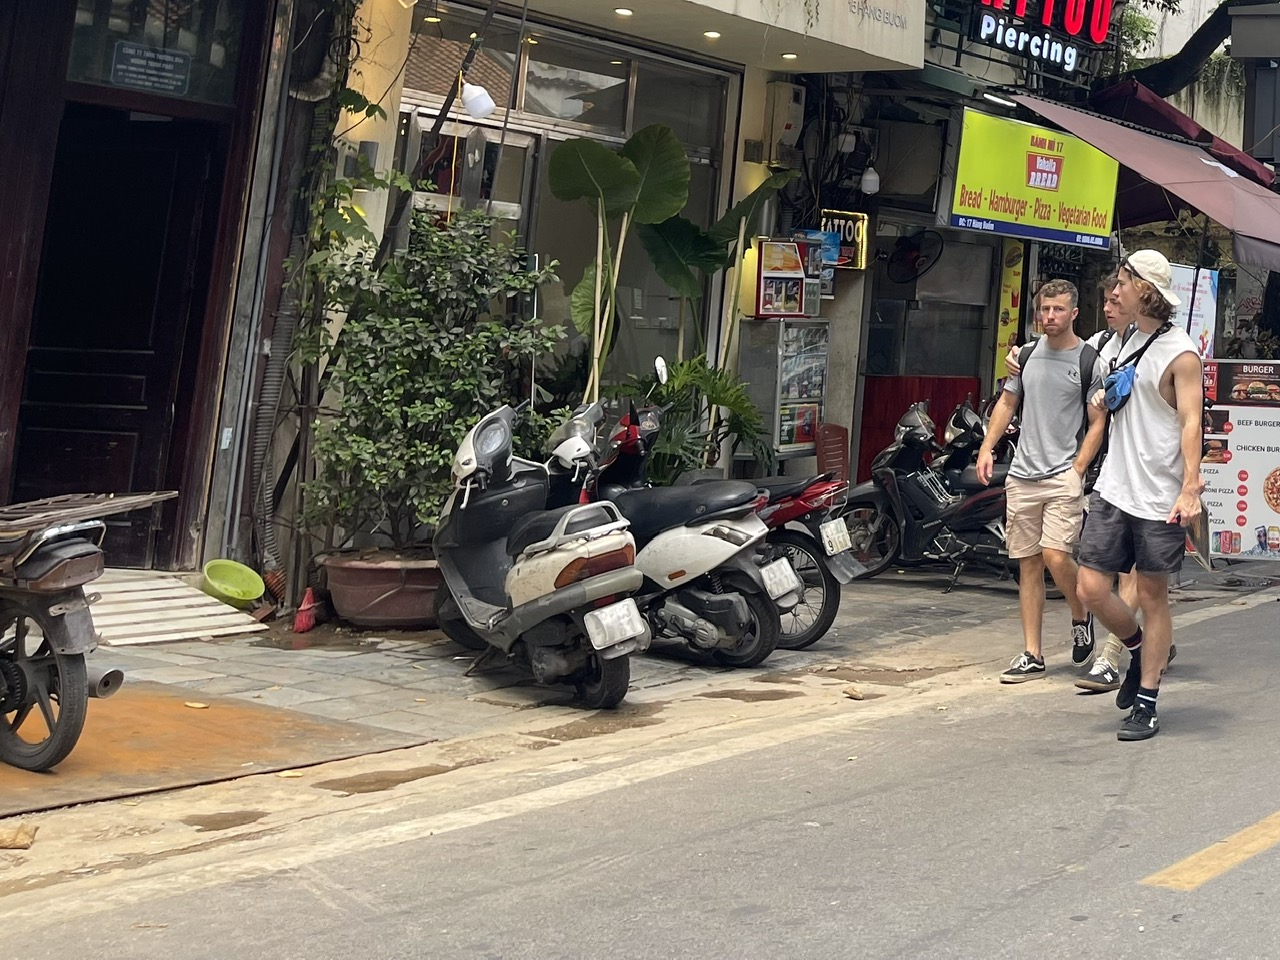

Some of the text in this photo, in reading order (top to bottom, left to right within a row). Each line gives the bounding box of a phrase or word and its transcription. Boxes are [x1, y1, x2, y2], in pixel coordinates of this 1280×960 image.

[980, 14, 1077, 72] Piercing
[1056, 141, 1064, 153] 17
[1028, 171, 1059, 188] BREAD
[959, 184, 1108, 229] Bread Hamburger Pizza Vegetarian Food
[1242, 365, 1274, 374] BURGER
[1254, 420, 1280, 428] BURGER
